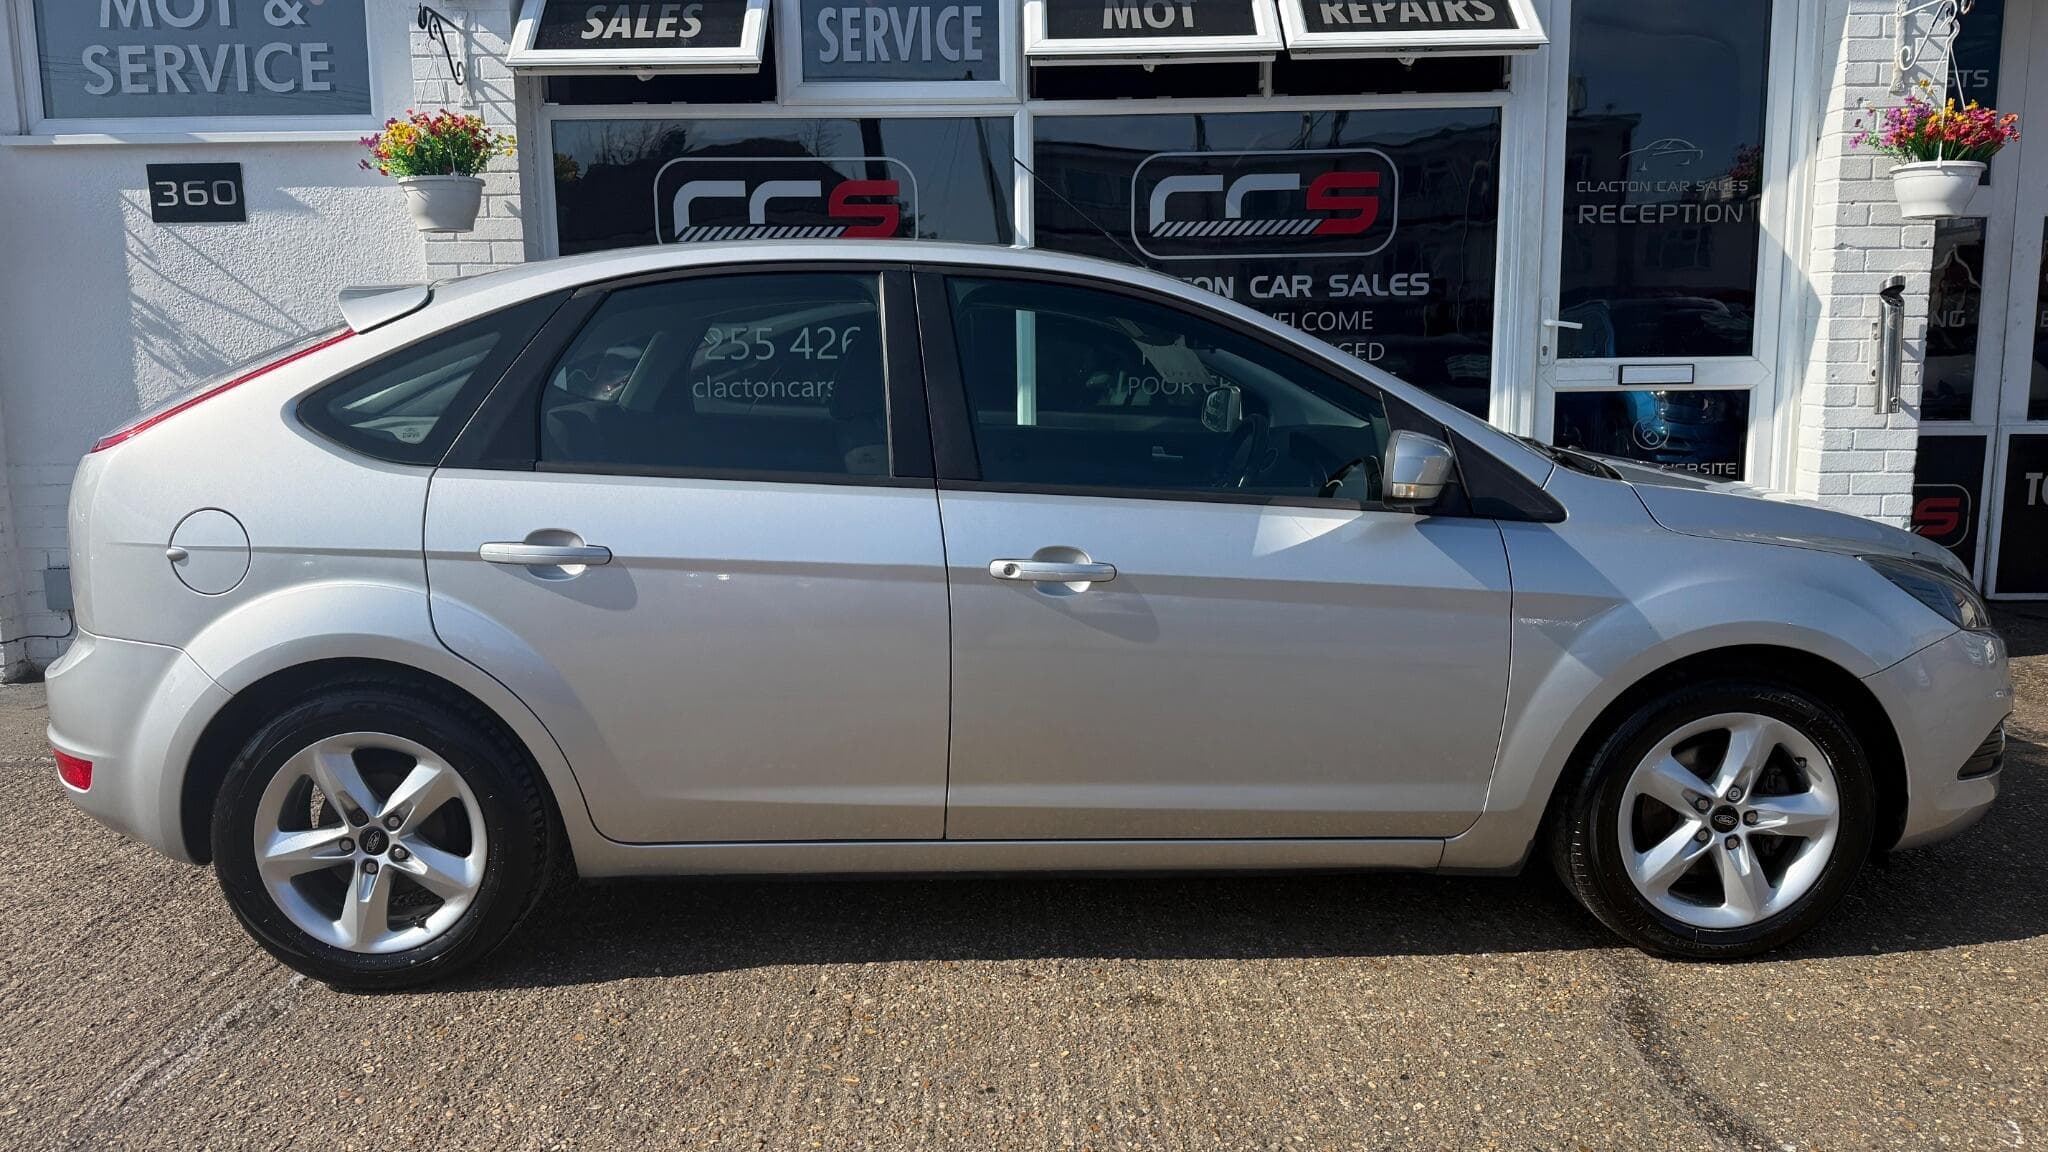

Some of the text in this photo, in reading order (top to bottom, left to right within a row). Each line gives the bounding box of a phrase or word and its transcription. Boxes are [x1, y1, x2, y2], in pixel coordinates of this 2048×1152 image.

[100, 0, 306, 28] MOT &
[580, 4, 703, 40] SALES
[1102, 0, 1198, 30] MOT
[1322, 0, 1497, 25] REPAIRS
[817, 6, 983, 63] SERVICE
[81, 42, 331, 95] SERVICE
[154, 179, 238, 208] 360
[1576, 179, 1749, 193] CLACTON CAR SALES
[1578, 203, 1744, 225] RECEPTION
[1250, 275, 1313, 299] CAR
[1328, 272, 1430, 298] SALES
[1272, 310, 1374, 331] ELCOME
[703, 327, 776, 361] 255
